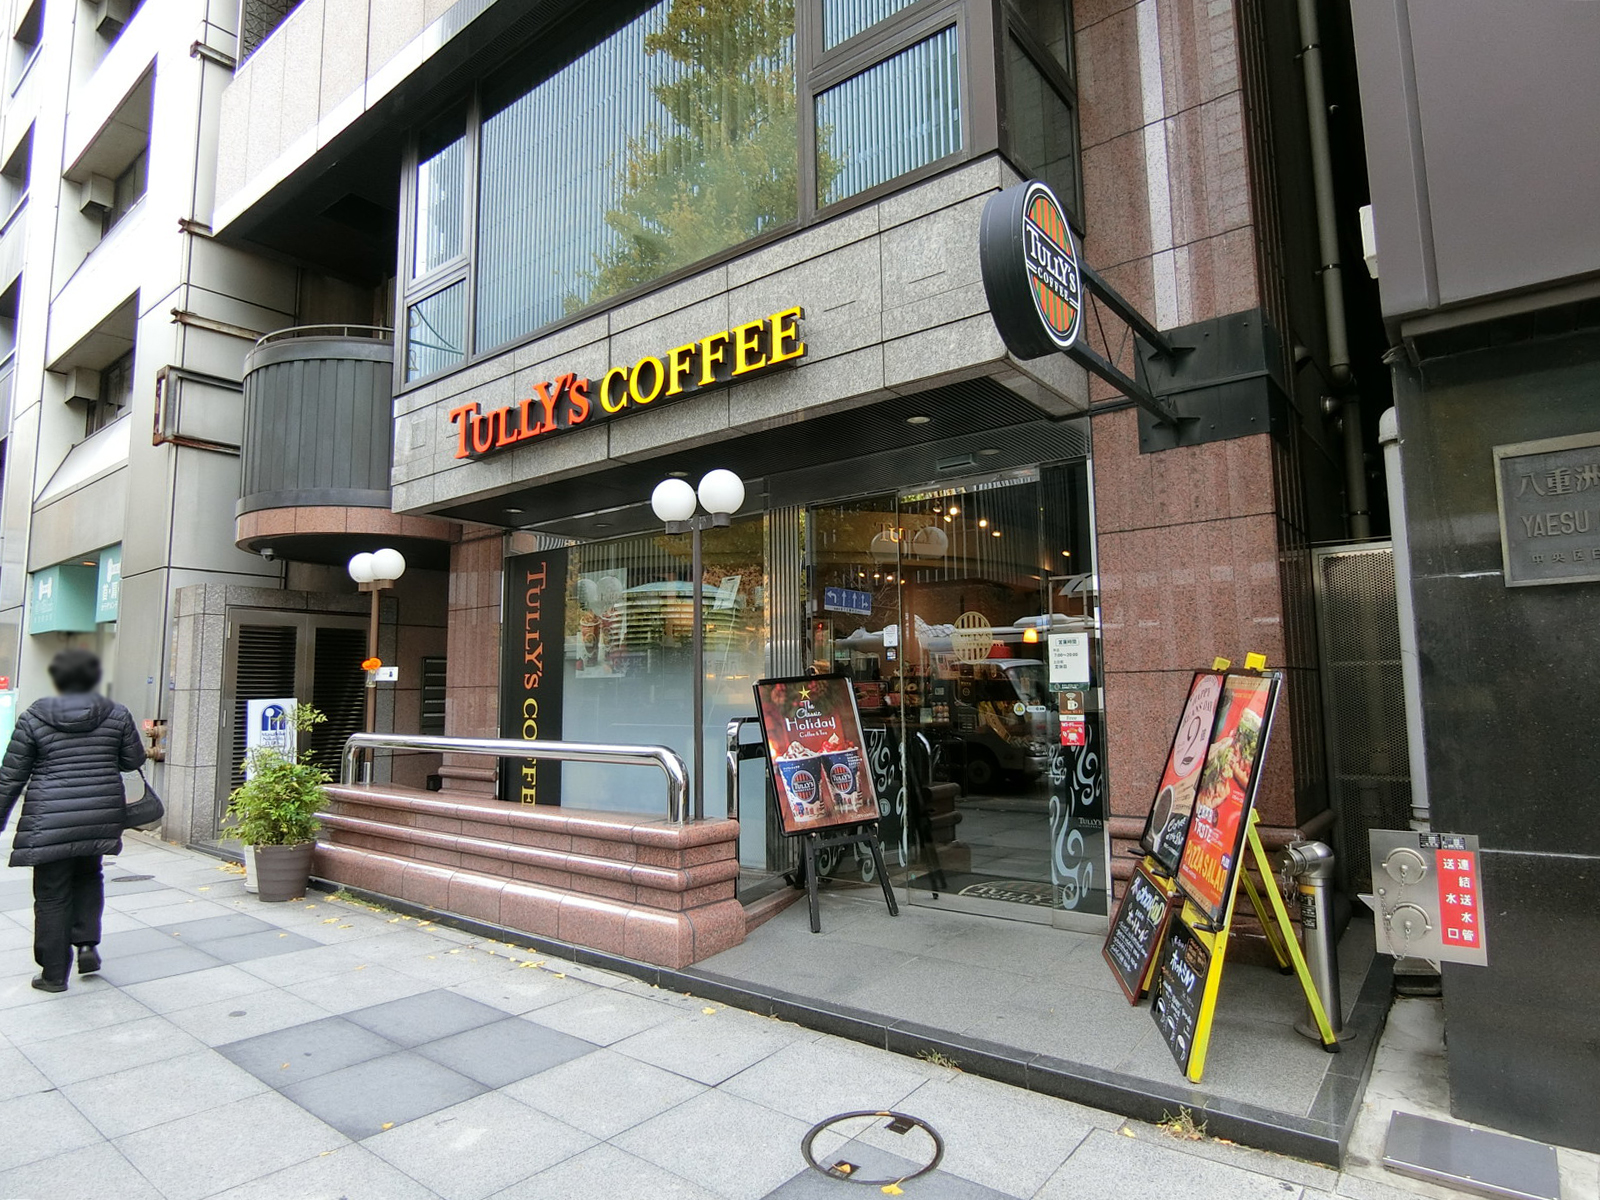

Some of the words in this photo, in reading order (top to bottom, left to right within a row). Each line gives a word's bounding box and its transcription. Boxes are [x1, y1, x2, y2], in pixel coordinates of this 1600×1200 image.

[1026, 224, 1077, 293] TULLY'S
[1037, 266, 1070, 302] COFFEE
[449, 372, 592, 460] TULLY'S
[600, 305, 806, 413] COFFEE
[1520, 509, 1589, 538] YAESU
[524, 562, 547, 690] TULLY'S
[796, 707, 822, 718] Classic
[800, 700, 815, 711] The
[785, 717, 836, 732] Holiday
[1078, 817, 1102, 826] TULLY'S
[1443, 858, 1460, 940] 送水口
[1457, 859, 1475, 942] 連結送水管
